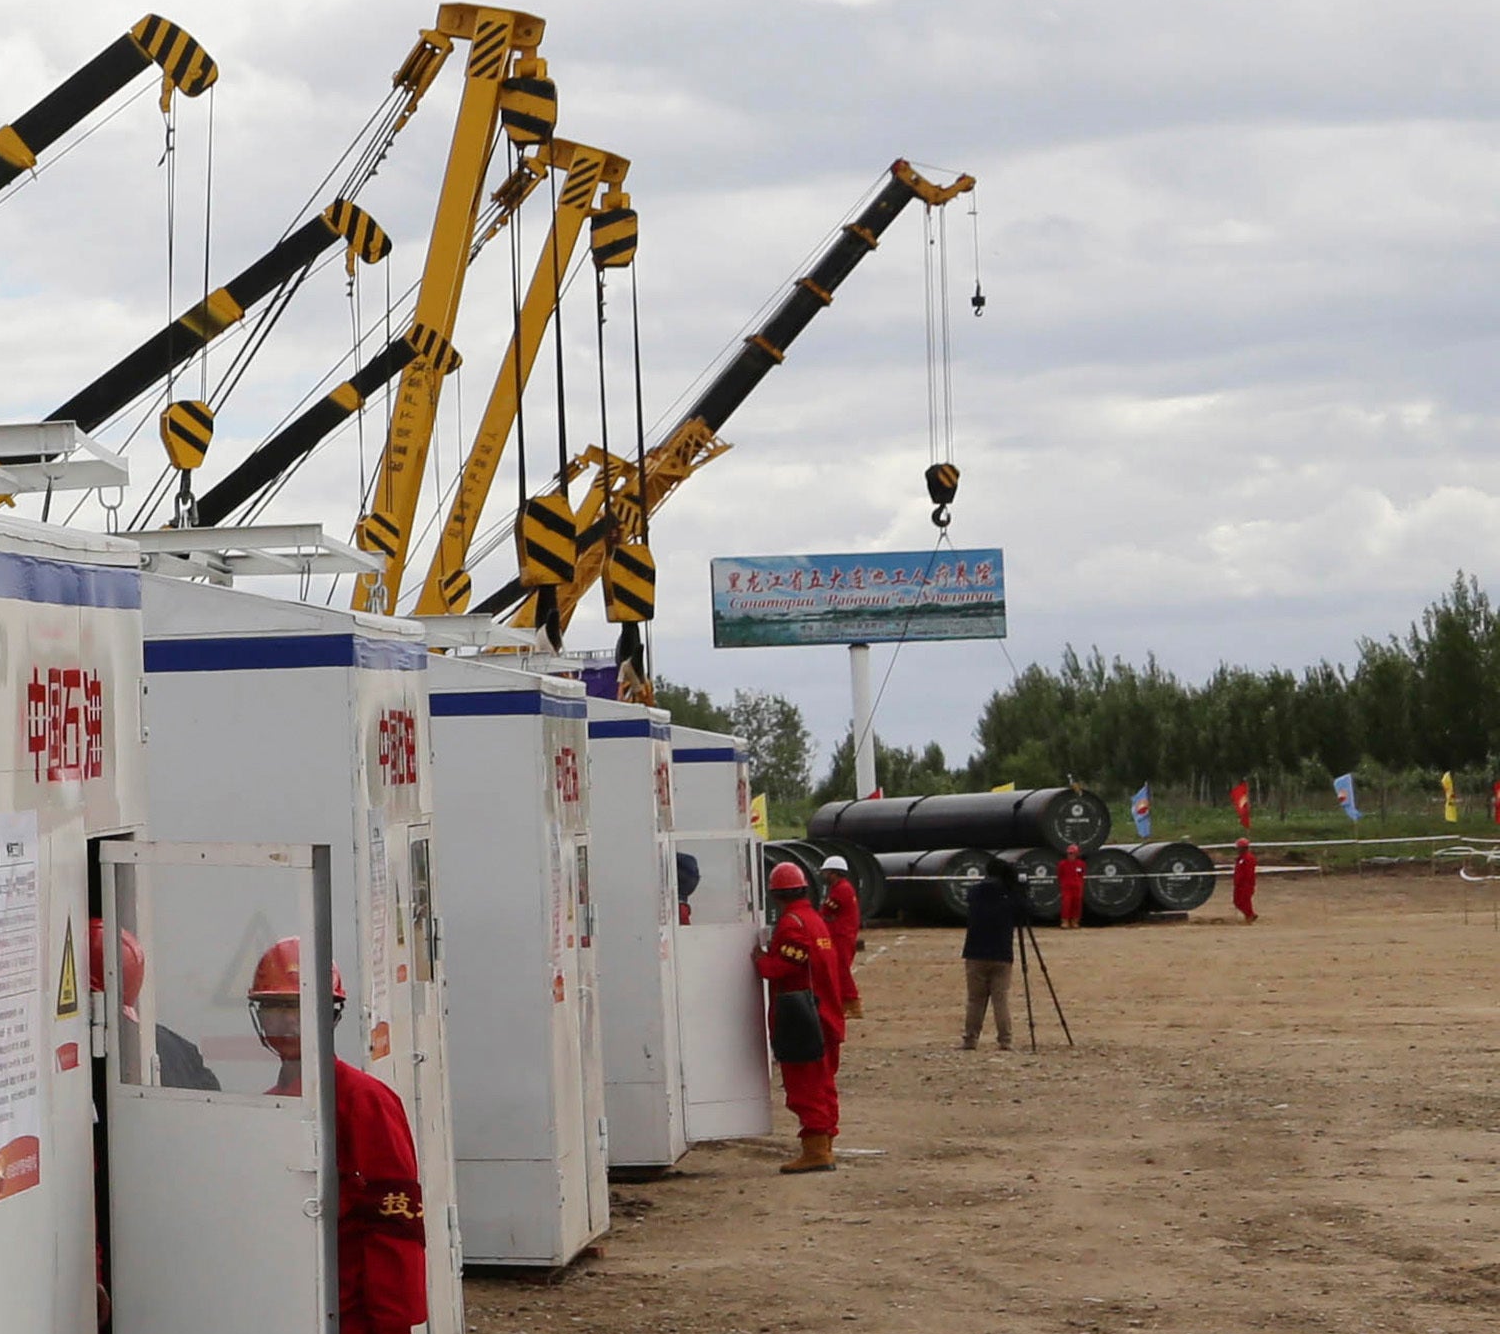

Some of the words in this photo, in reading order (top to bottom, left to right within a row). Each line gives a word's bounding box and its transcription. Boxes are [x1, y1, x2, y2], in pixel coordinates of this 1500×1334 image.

[28, 666, 102, 783] 中国石油
[379, 709, 417, 786] 中国石油
[380, 1192, 424, 1219] 技
